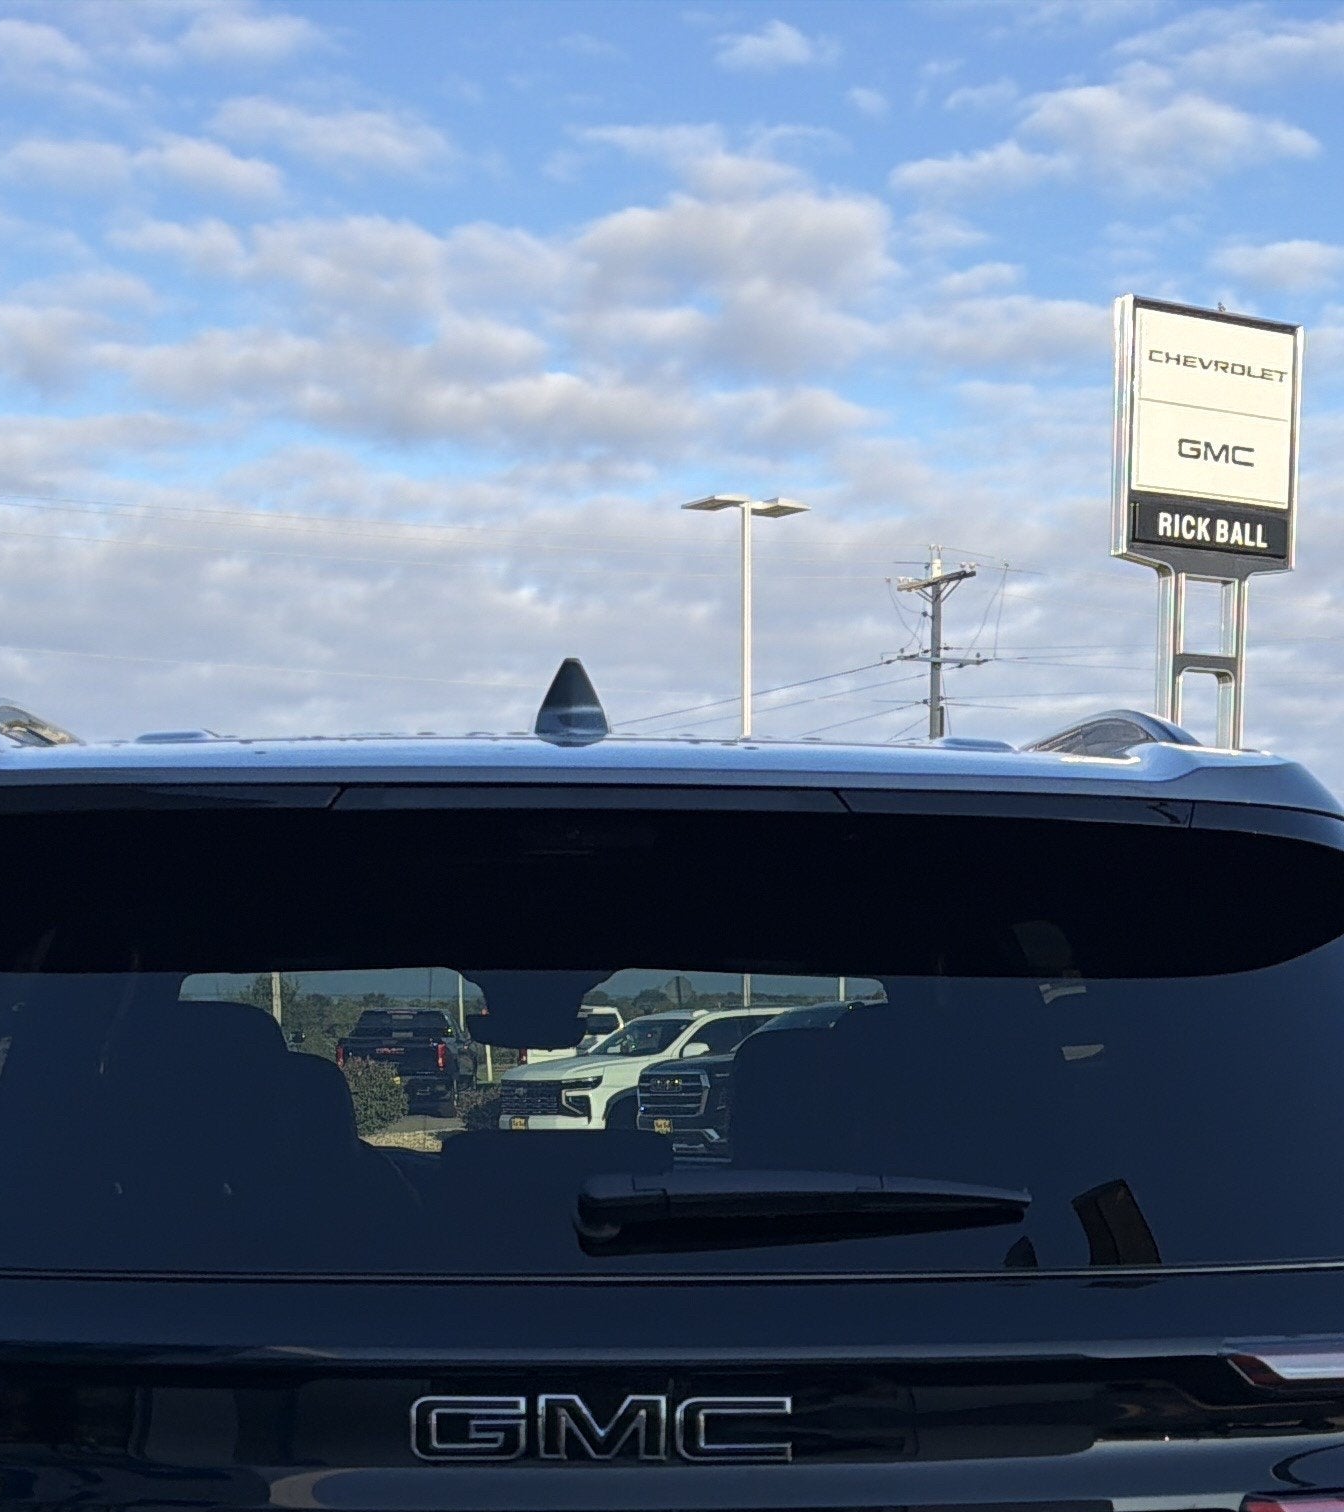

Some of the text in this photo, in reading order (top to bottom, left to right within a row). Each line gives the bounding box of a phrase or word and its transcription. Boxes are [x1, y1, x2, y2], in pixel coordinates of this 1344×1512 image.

[1148, 349, 1288, 383] CHEVROLET
[1177, 437, 1254, 467] GMC
[1158, 511, 1269, 548] RICK BALL
[409, 1394, 793, 1462] GMC
